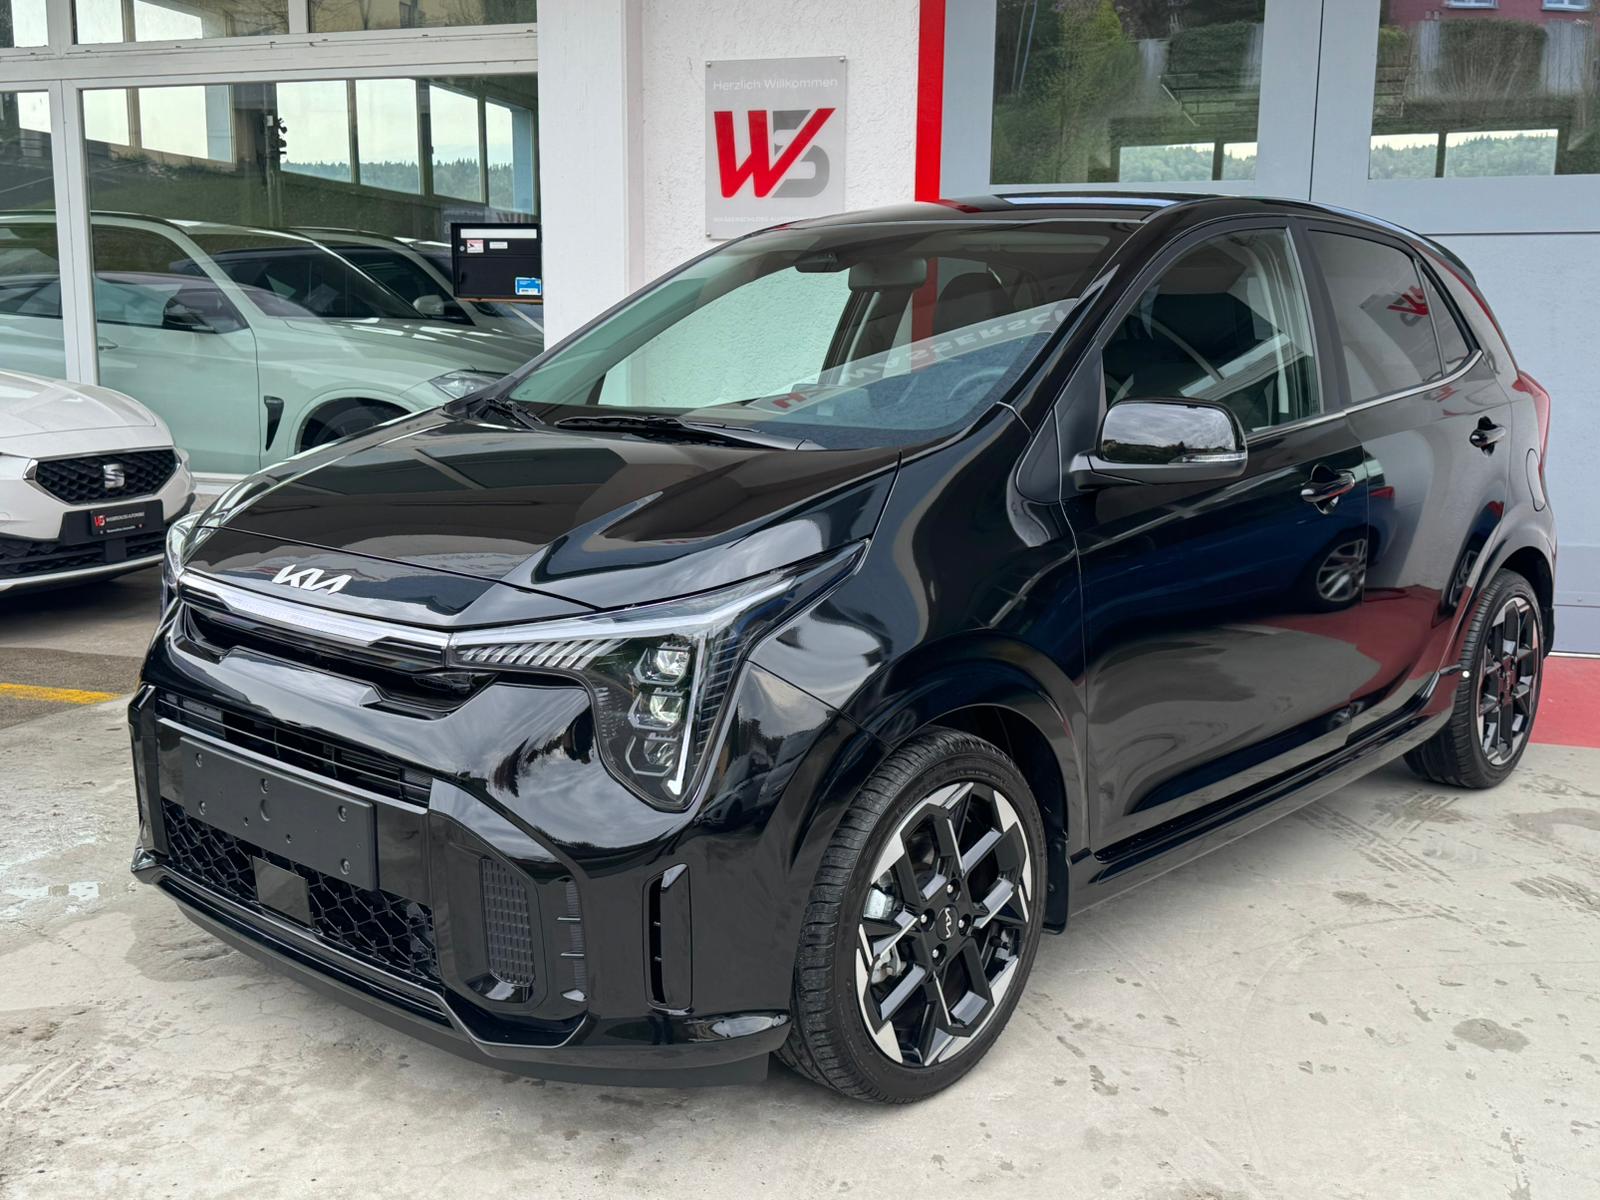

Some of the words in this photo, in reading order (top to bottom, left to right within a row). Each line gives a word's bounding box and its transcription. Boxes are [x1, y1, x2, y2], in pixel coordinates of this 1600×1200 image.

[713, 79, 761, 92] Herzlich
[763, 77, 838, 90] Willkommen
[271, 563, 353, 596] KIA
